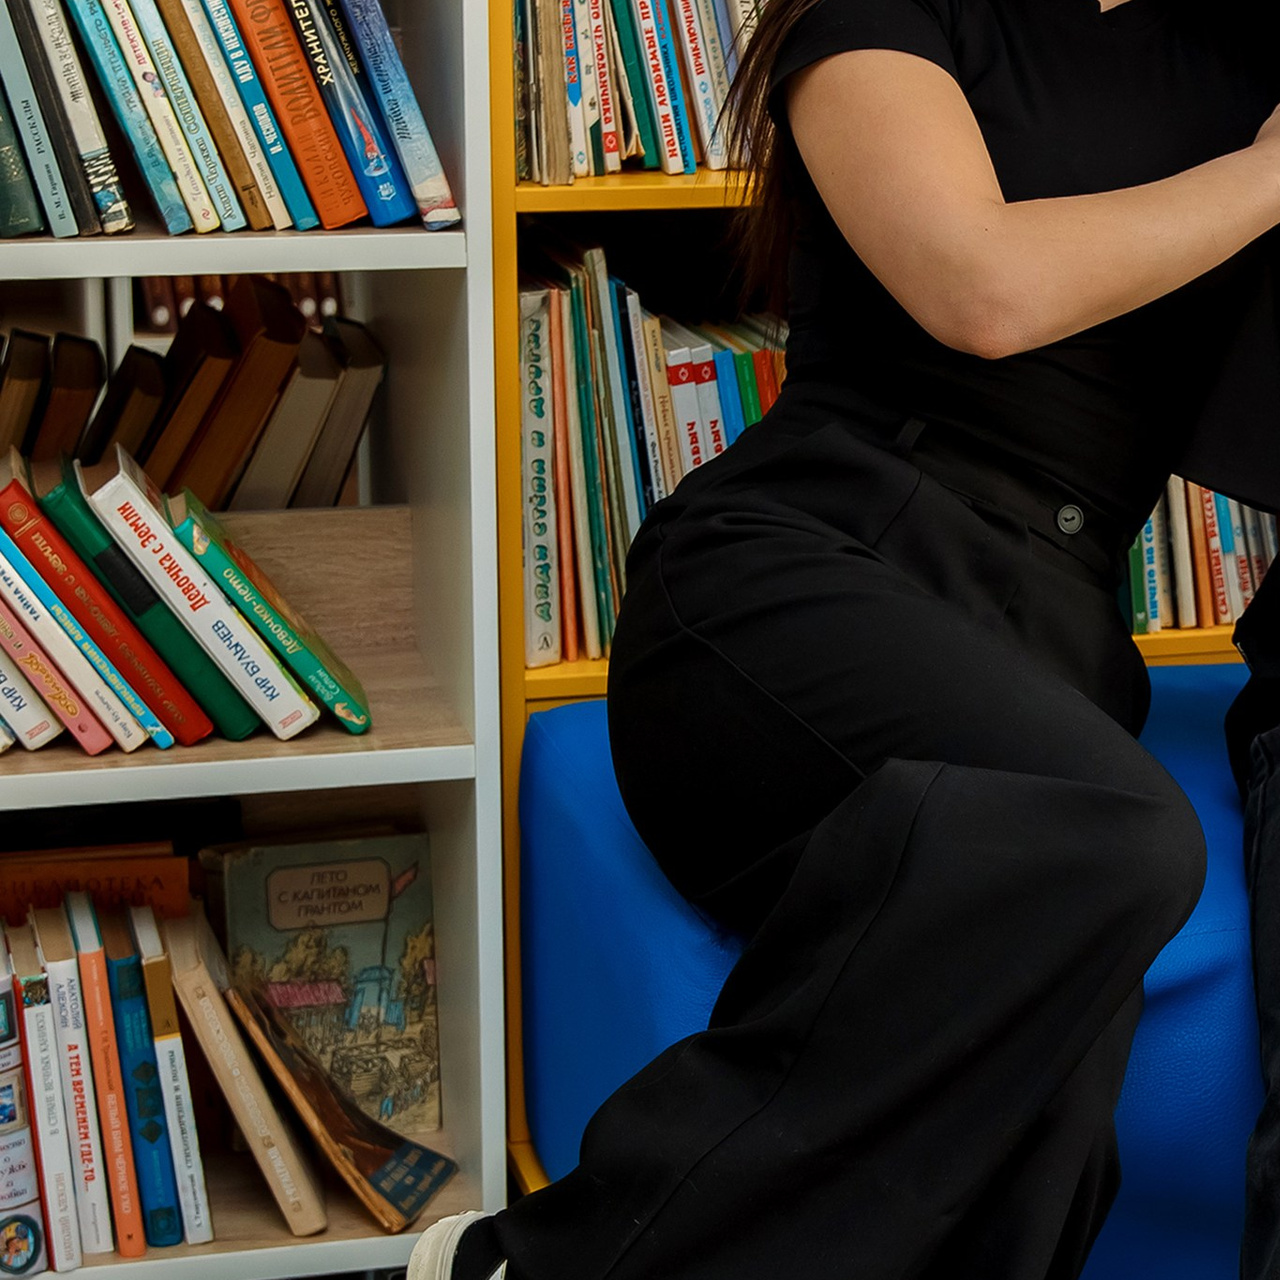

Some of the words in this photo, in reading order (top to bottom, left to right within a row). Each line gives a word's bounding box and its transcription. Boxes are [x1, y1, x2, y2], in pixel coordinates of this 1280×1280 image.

[228, 51, 245, 59] В
[232, 63, 254, 83] ИДУ
[153, 543, 165, 551] с
[159, 553, 210, 612] Девочка
[223, 568, 303, 654] Девочка-лето
[211, 619, 261, 673] БУЛЫЧЕВ
[256, 676, 281, 702] КИР
[311, 870, 346, 885] ЛЕТО
[278, 891, 289, 904] С
[293, 884, 381, 903] КАПИТАНОМ
[297, 901, 364, 918] ГРАНТОМ
